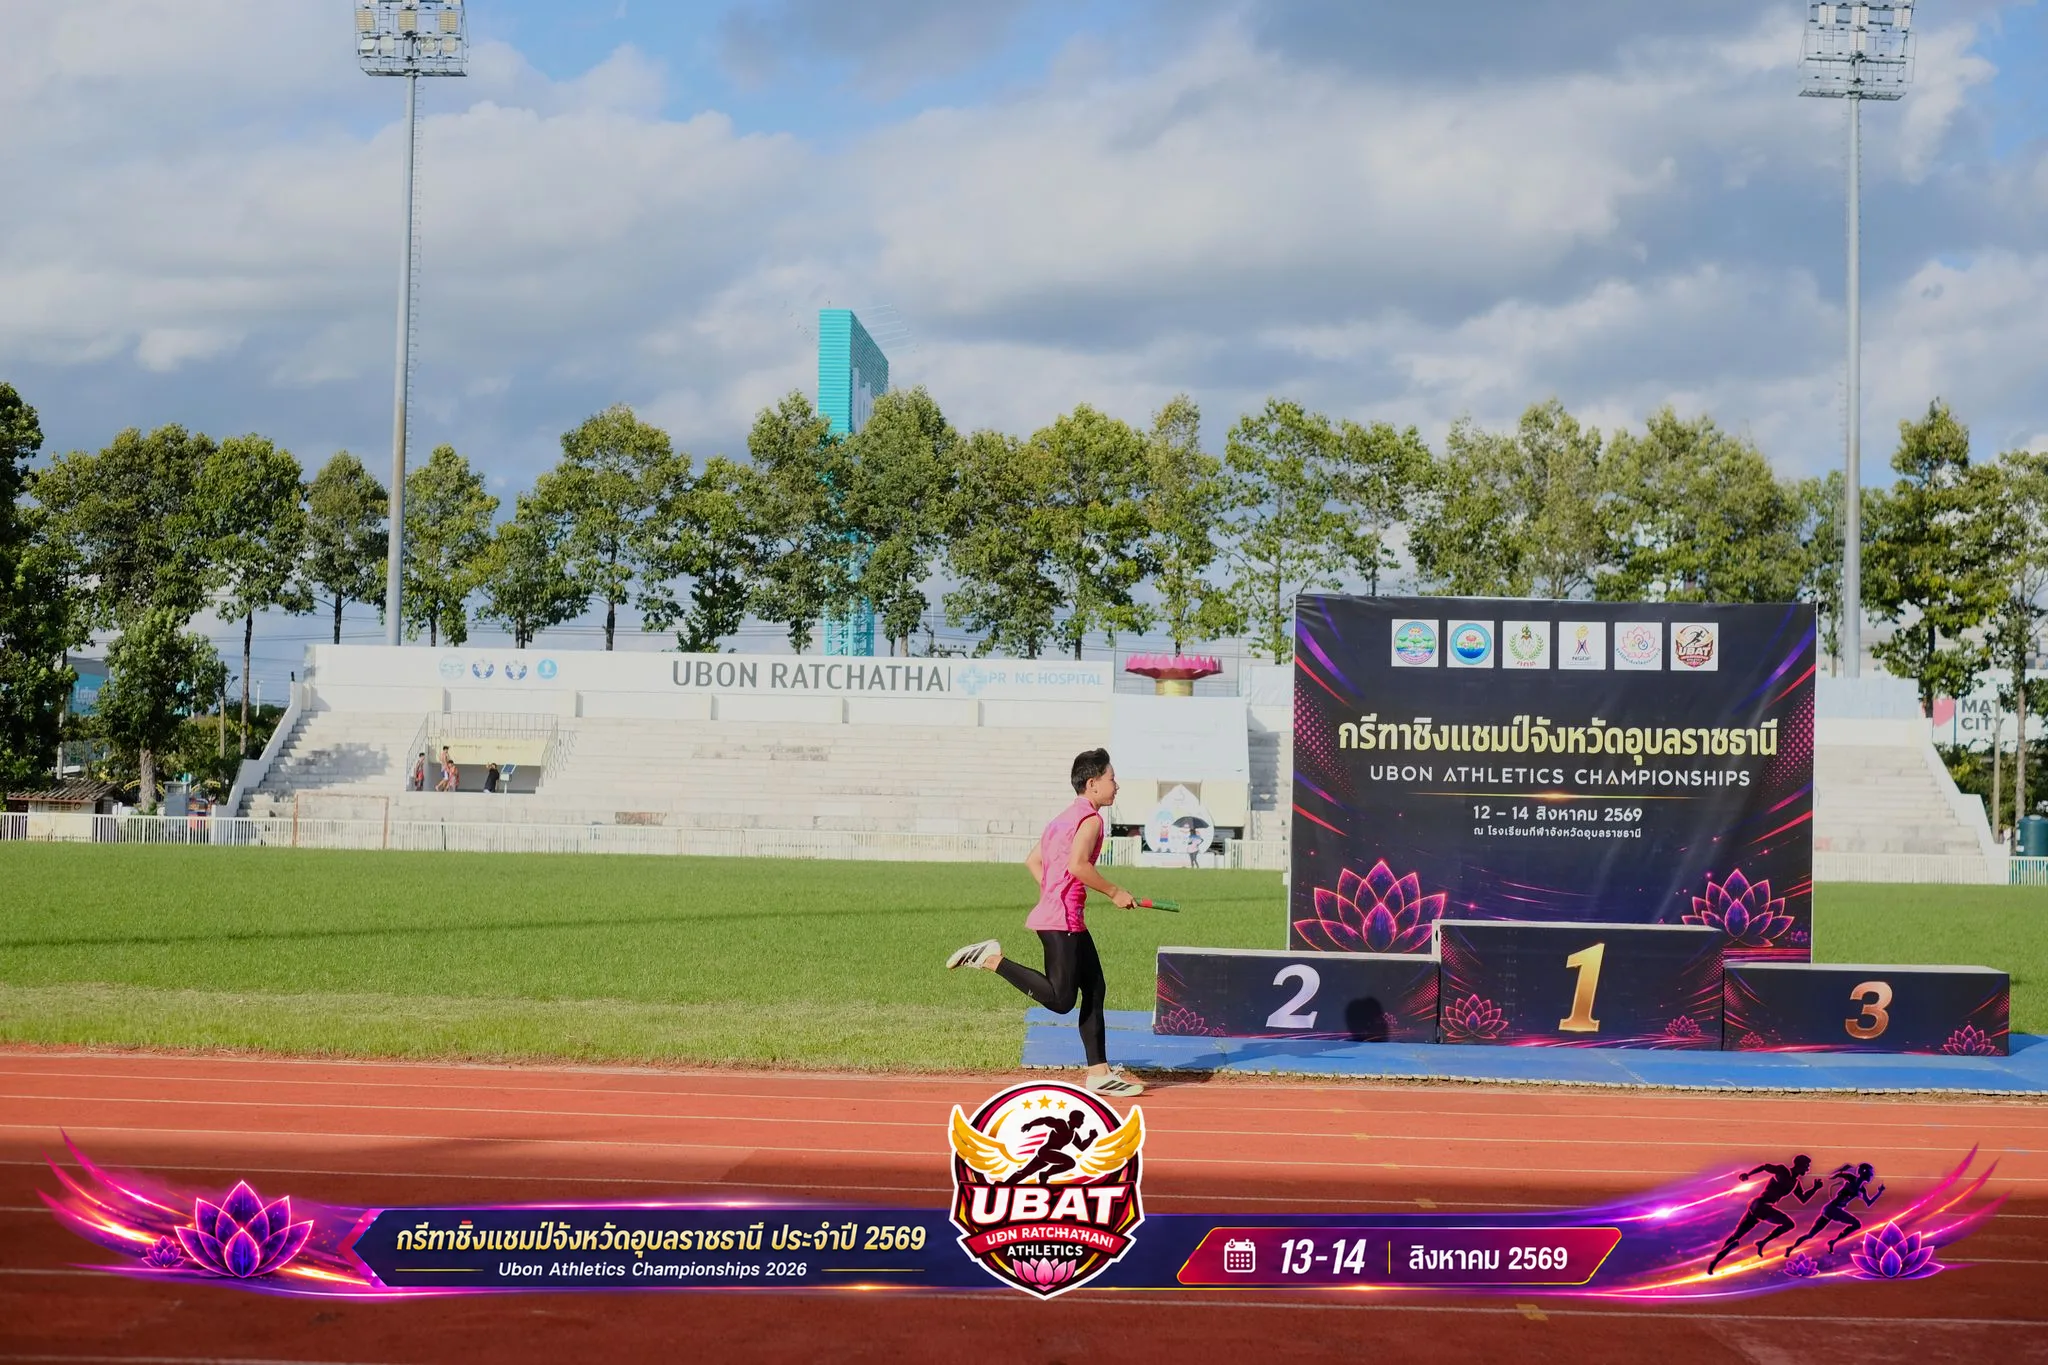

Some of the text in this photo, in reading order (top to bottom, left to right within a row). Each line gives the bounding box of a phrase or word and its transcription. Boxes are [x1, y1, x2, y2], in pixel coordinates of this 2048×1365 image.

[673, 660, 951, 692] UBON RATCHATHA
[1037, 672, 1105, 686] HOSPITAL
[1338, 713, 1778, 766] กรีฑาชิงแชมป์จังหวัดอุบลราชธานี
[1370, 765, 1751, 787] UBON ATHLETICS CHAMPIONSHIPS
[1473, 805, 1491, 819] 12
[1511, 806, 1529, 820] 14
[1535, 805, 1598, 821] สิงหาคม
[1603, 807, 1643, 822] 2569
[1266, 963, 1319, 1030] 2
[1557, 942, 1606, 1033] 1
[1844, 980, 1893, 1040] 3
